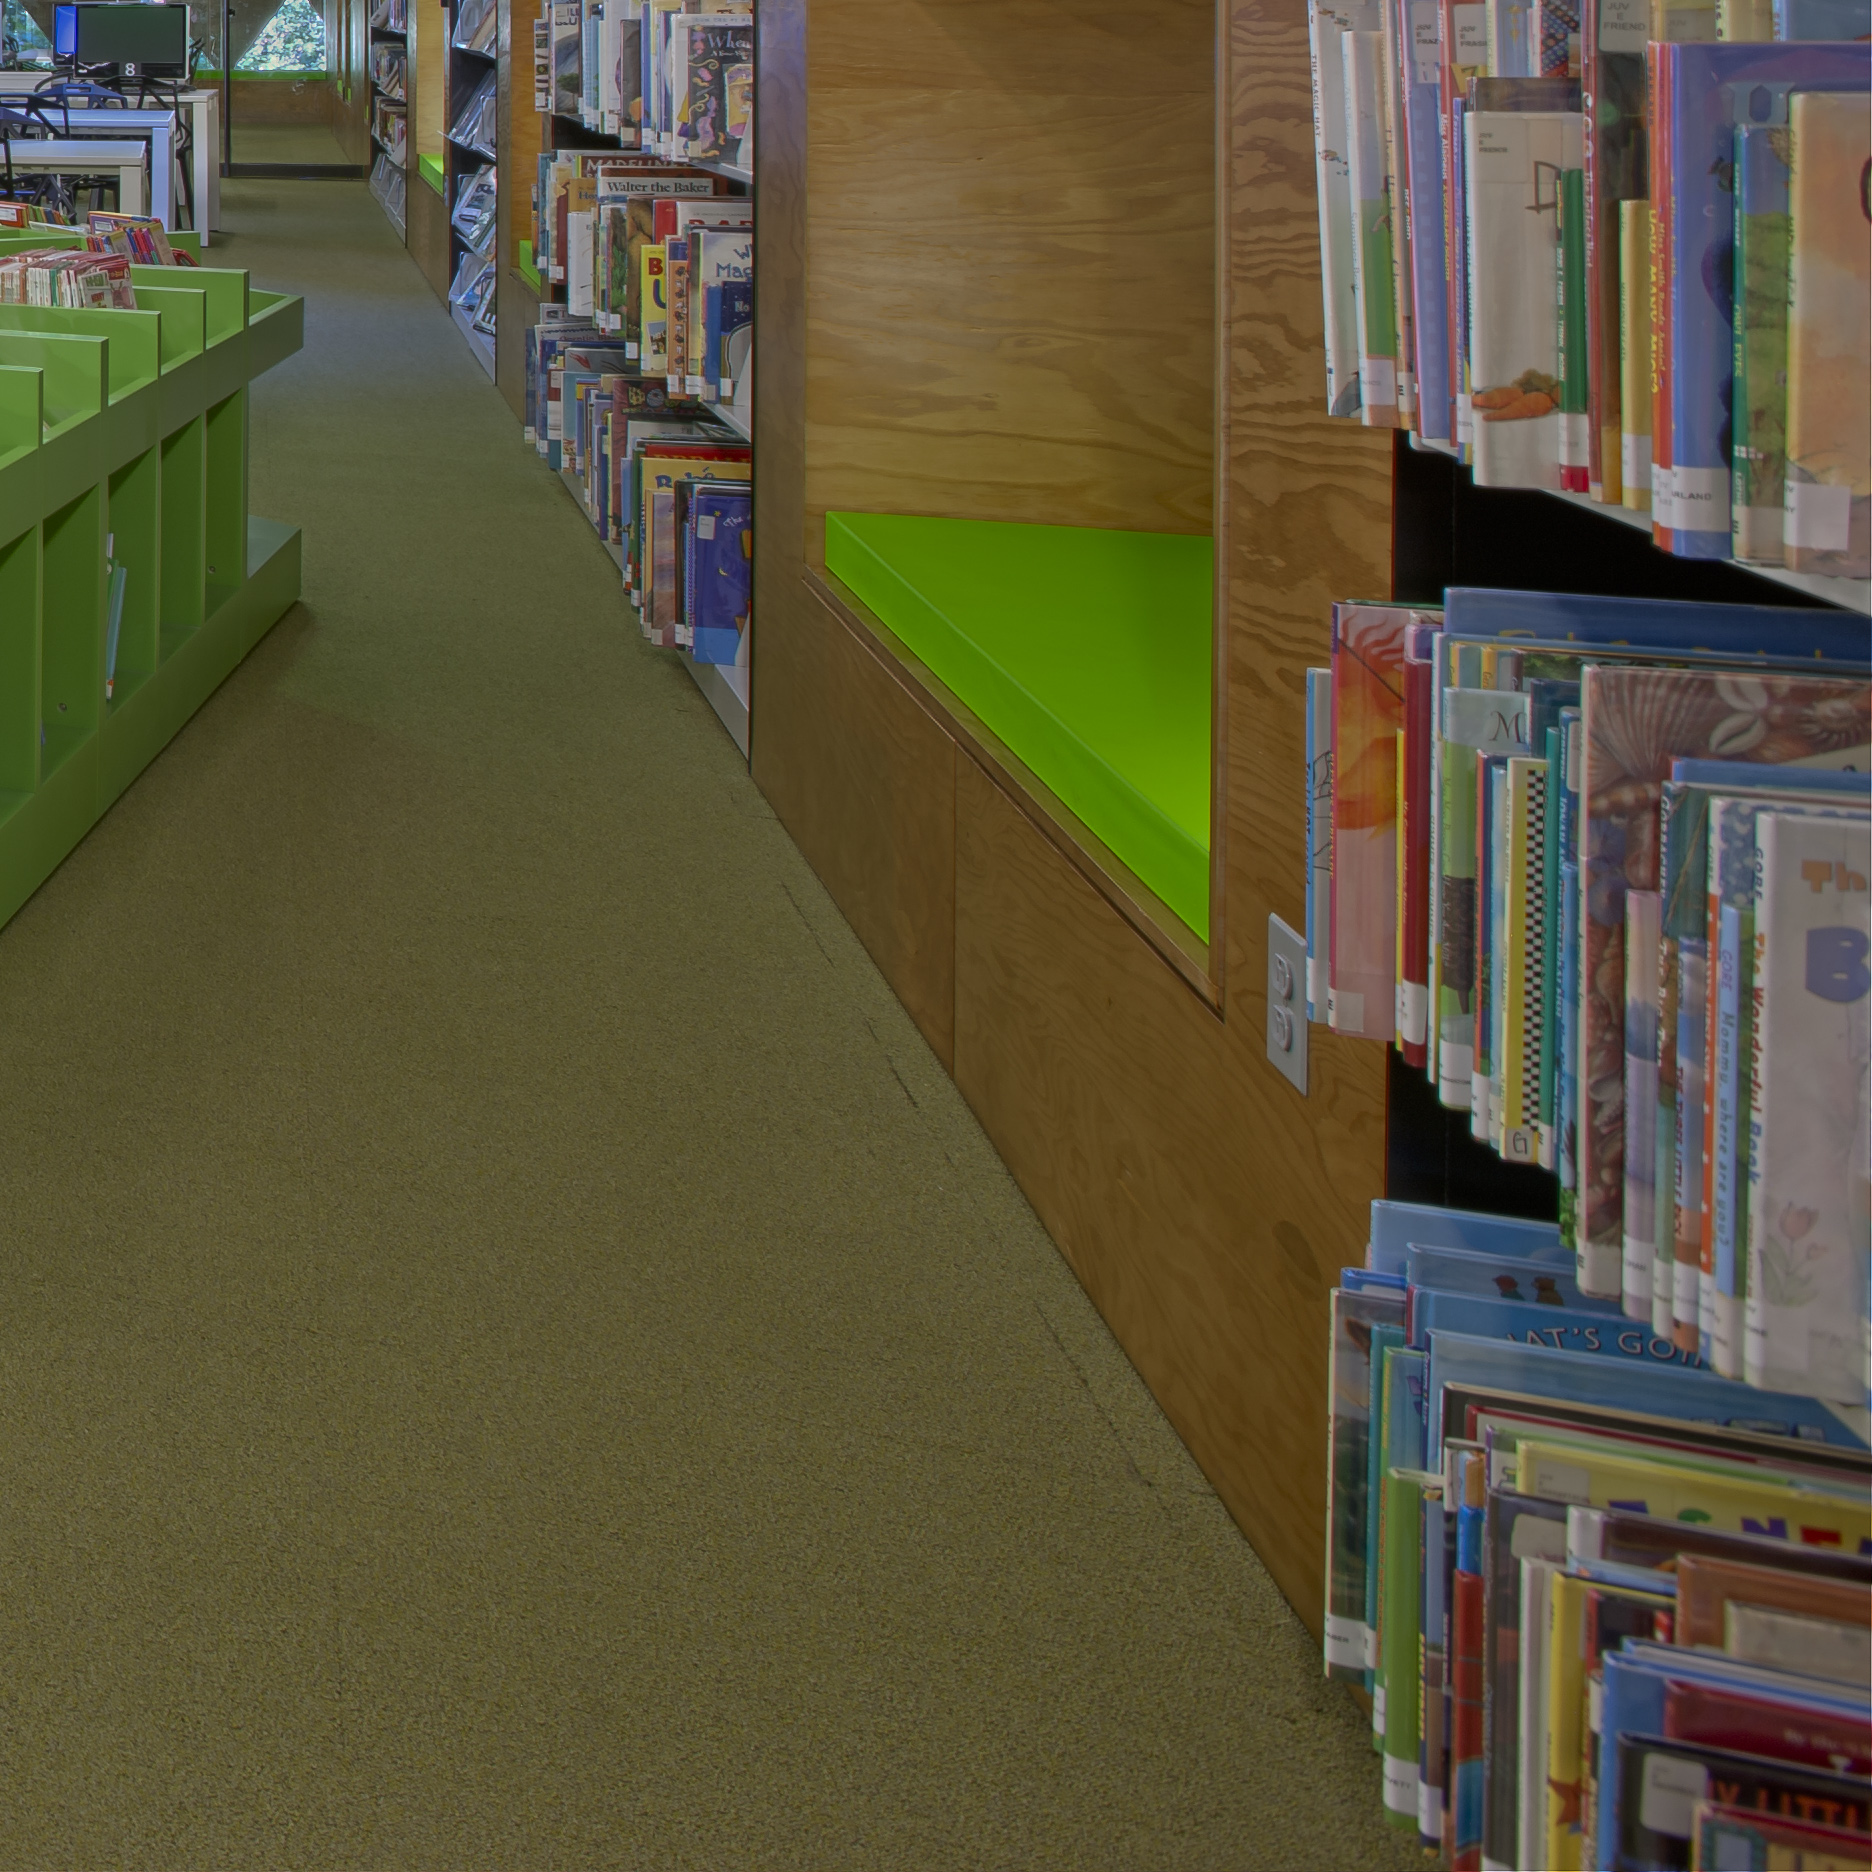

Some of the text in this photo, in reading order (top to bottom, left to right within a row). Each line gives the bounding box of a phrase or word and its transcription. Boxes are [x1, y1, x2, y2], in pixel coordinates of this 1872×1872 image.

[1607, 3, 1630, 11] JUV
[1603, 21, 1647, 31] FRIEND
[125, 63, 135, 76] 8
[607, 181, 710, 194] Walter the Baker
[1721, 950, 1733, 991] GORE
[1747, 848, 1764, 1185] GORE The Wonderful Book
[1717, 1098, 1732, 1155] where
[1717, 1163, 1729, 1193] are
[1713, 1201, 1729, 1247] you?
